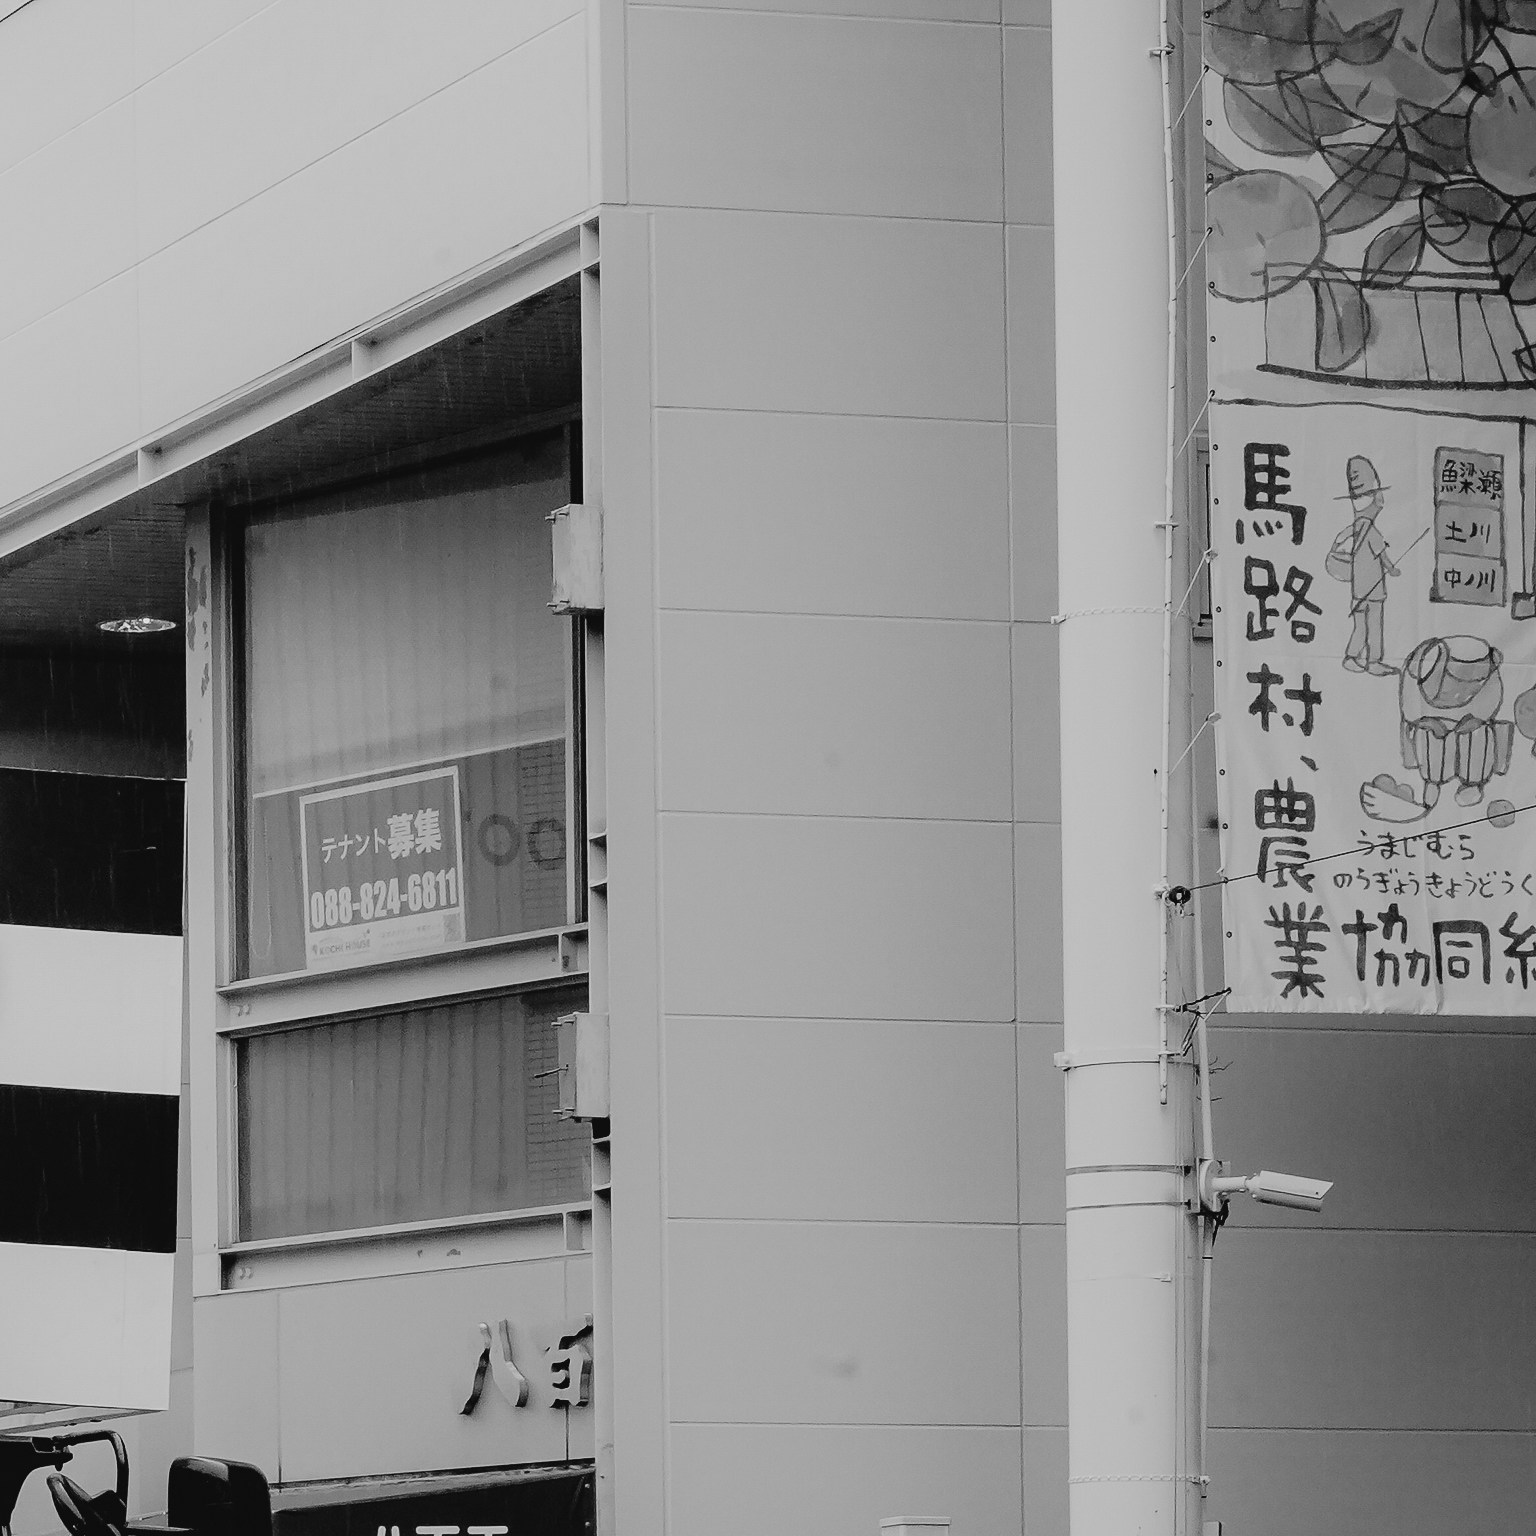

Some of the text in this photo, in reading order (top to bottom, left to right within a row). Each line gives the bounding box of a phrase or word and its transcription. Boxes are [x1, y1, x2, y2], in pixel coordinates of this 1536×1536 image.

[321, 807, 442, 864] テナント募集
[1358, 832, 1475, 861] うまじむら
[310, 867, 457, 929] 088-824-6811
